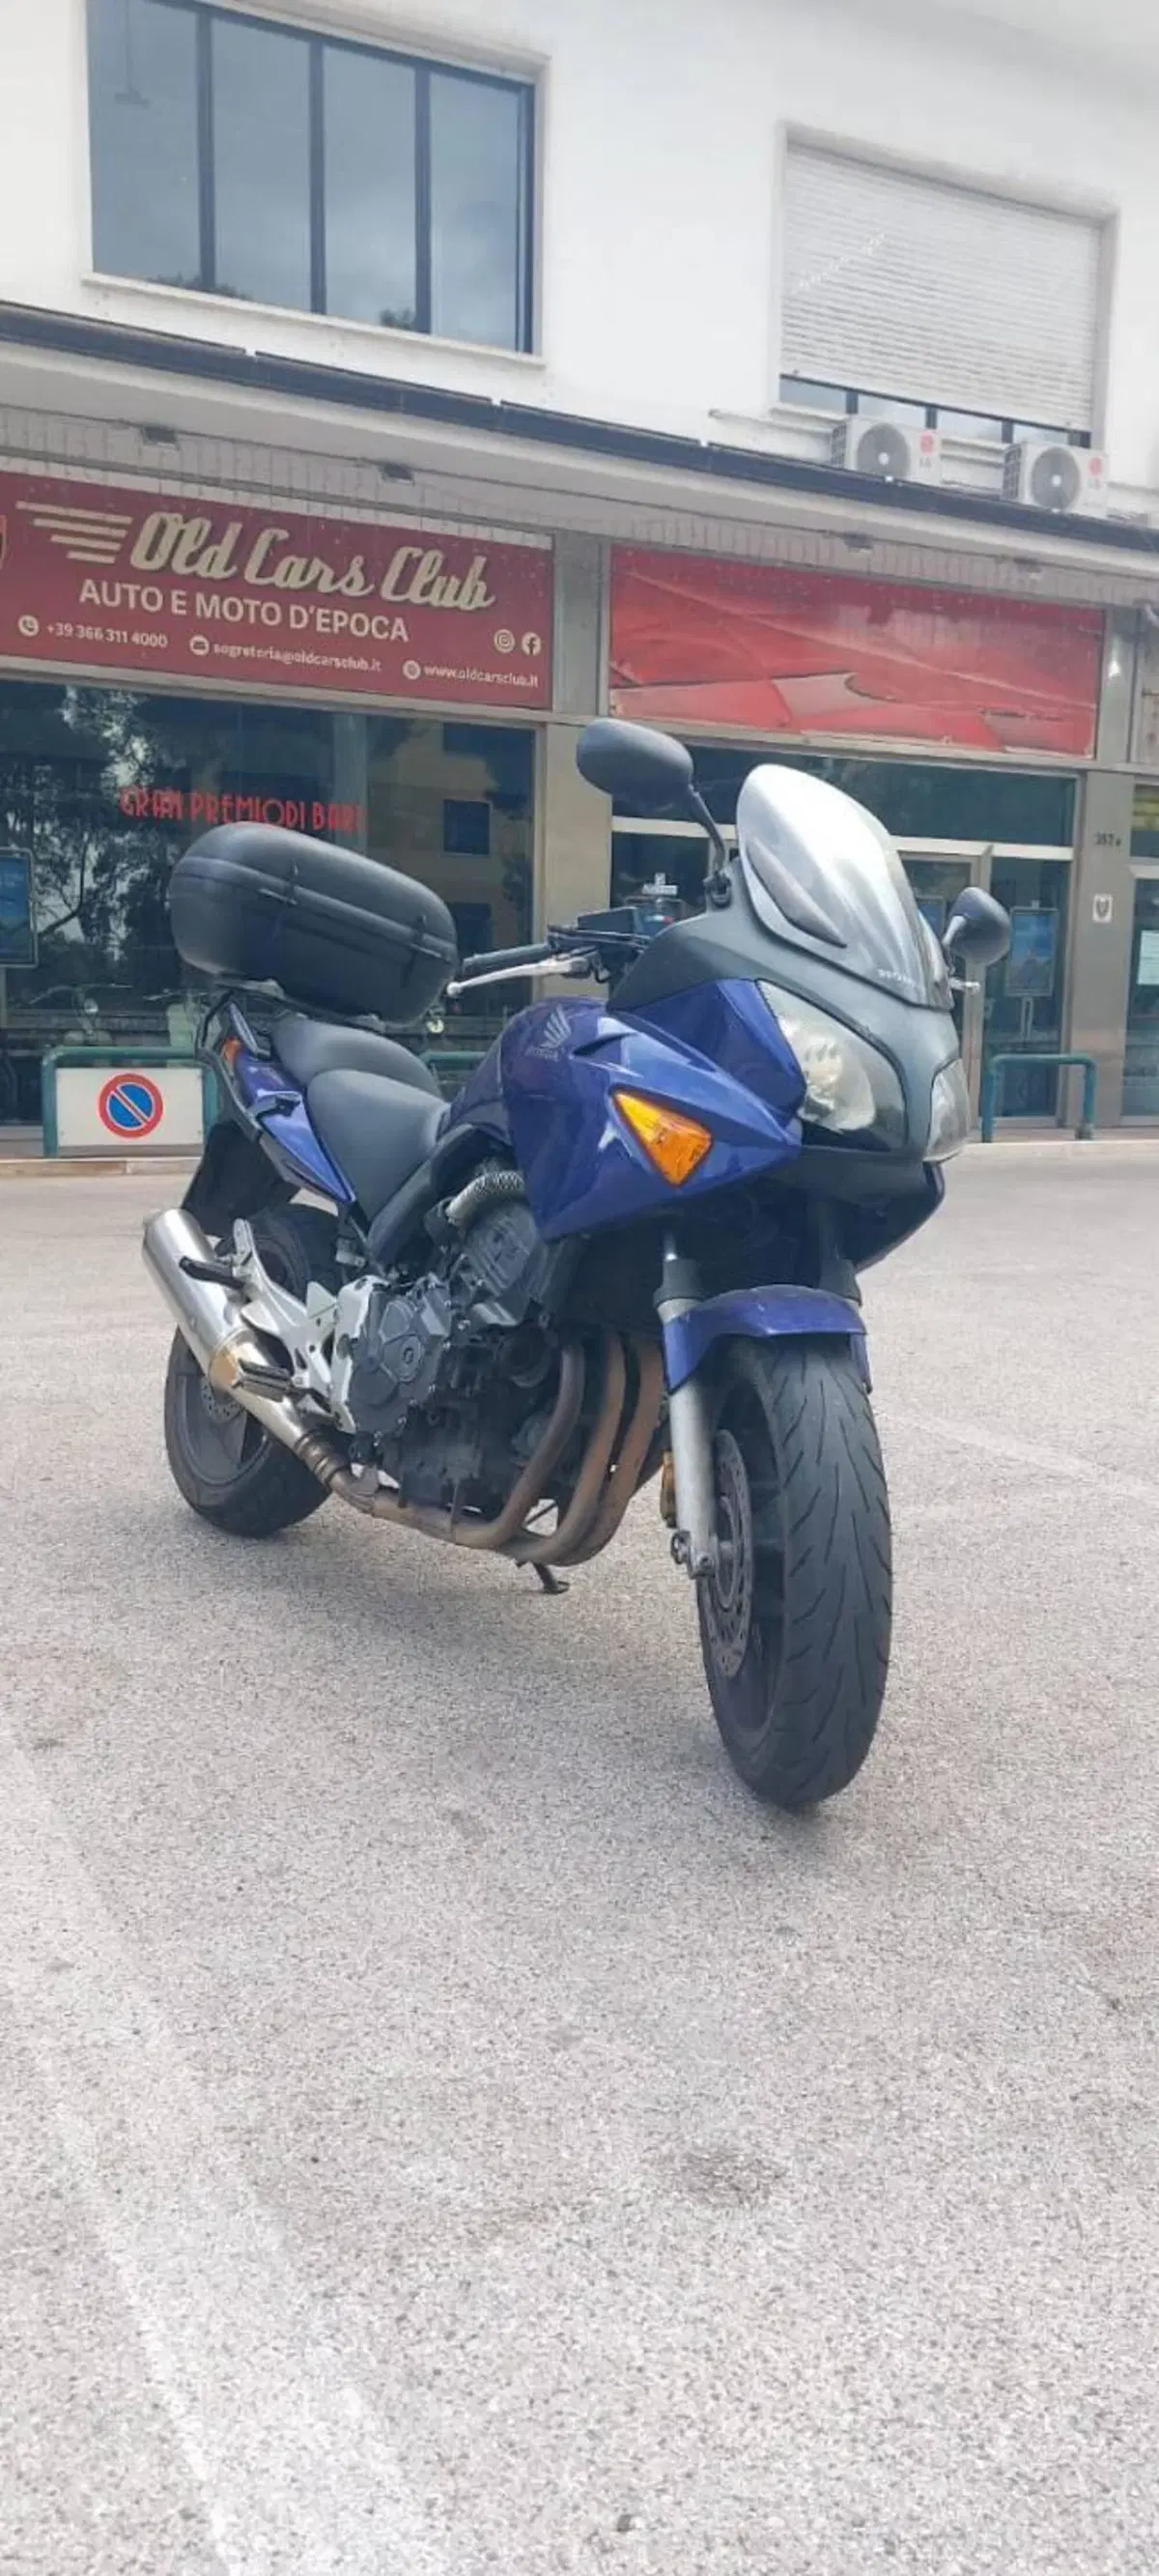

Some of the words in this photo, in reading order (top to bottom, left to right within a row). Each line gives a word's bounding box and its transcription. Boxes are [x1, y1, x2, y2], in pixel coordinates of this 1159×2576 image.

[130, 511, 242, 579] Old
[243, 528, 375, 597] Cars
[380, 546, 496, 611] Club
[79, 579, 163, 612] AUTO
[171, 589, 187, 615] E
[196, 592, 282, 626] MOTO
[290, 604, 409, 642] D'EPOCA
[47, 622, 73, 638] +39
[105, 629, 128, 644] 311
[131, 631, 168, 648] 4000
[423, 663, 539, 688] www.oldcarsclub.it
[119, 786, 184, 819] GRAN
